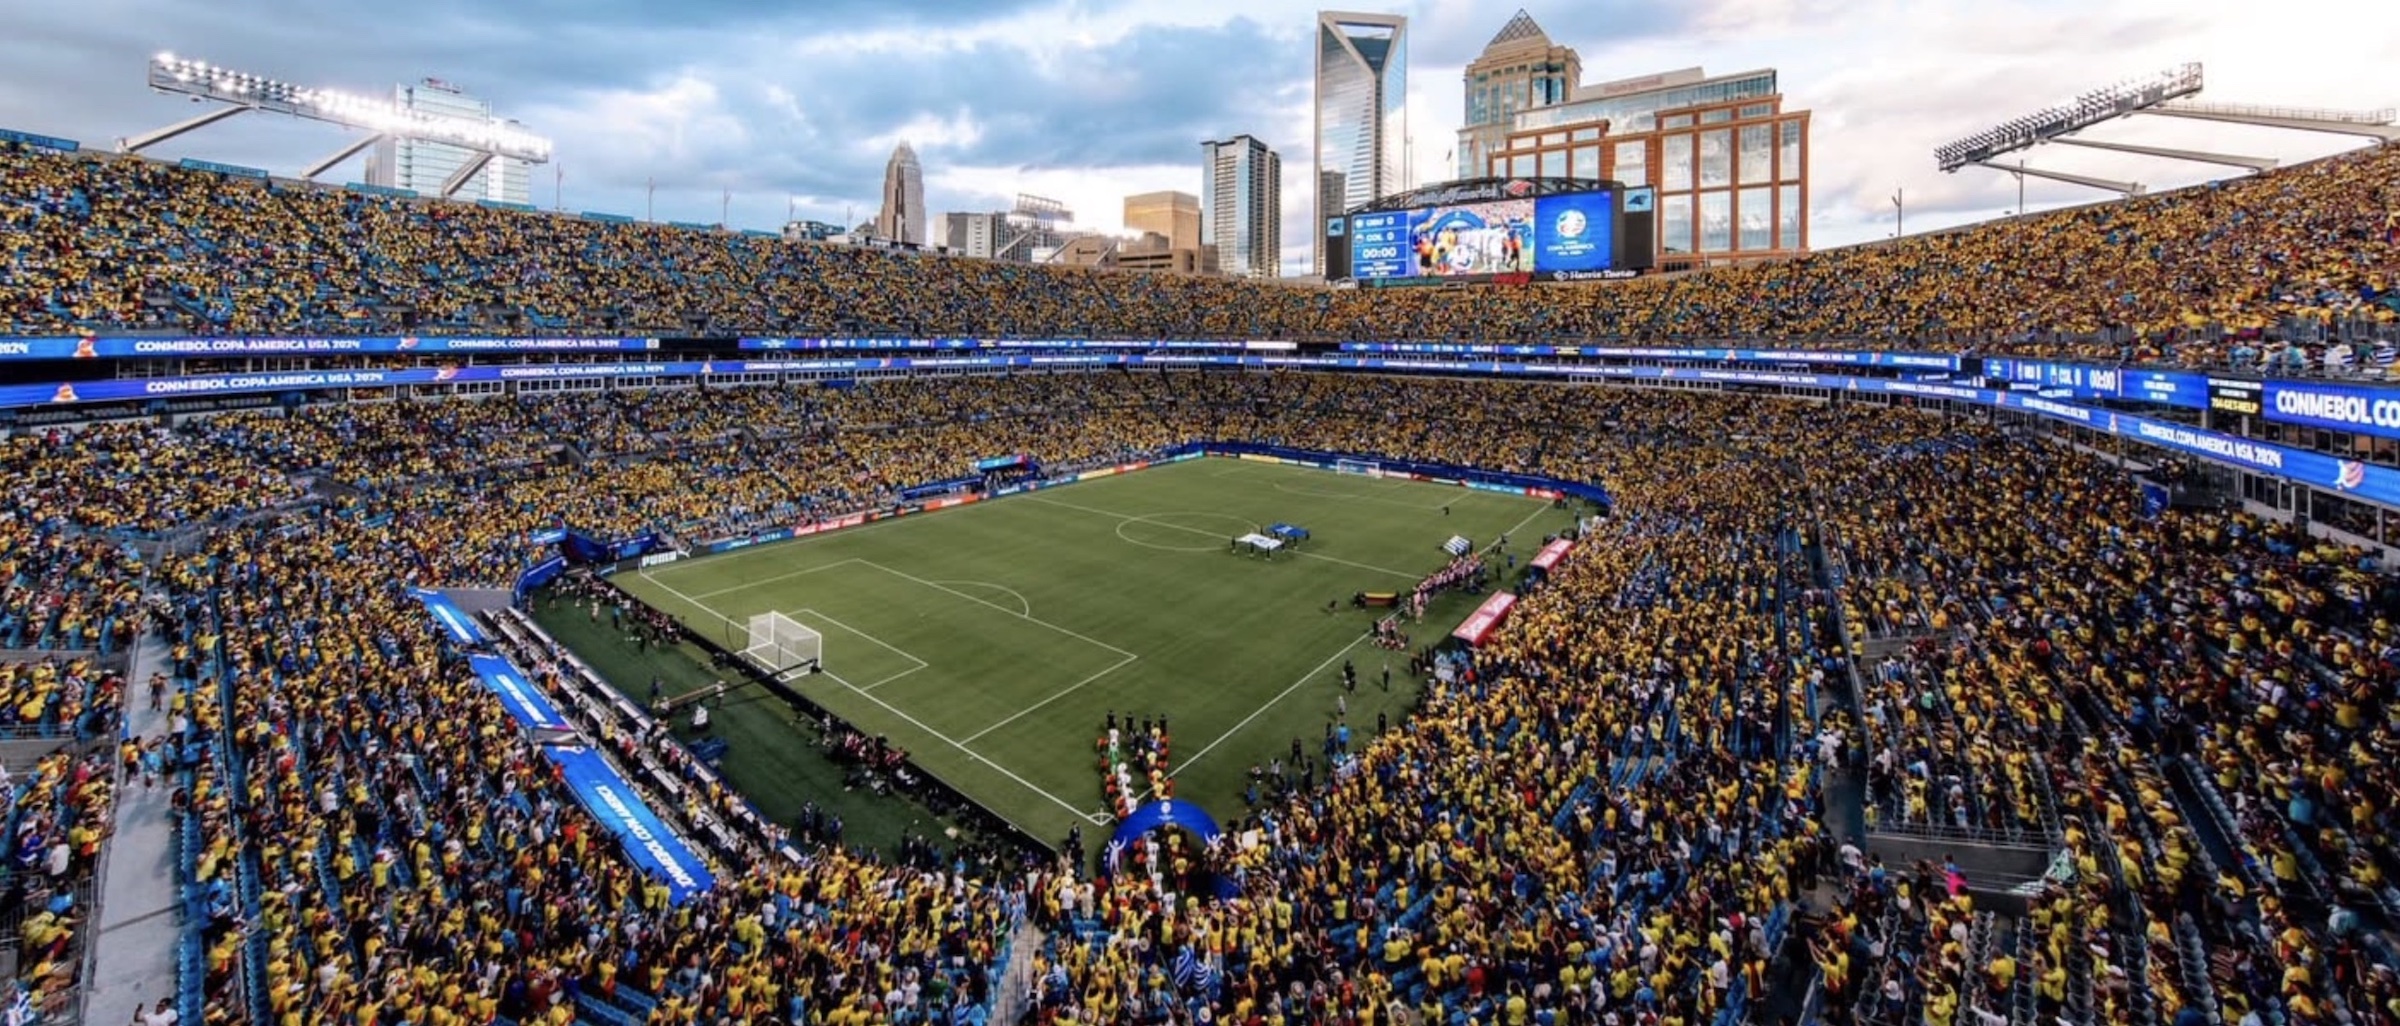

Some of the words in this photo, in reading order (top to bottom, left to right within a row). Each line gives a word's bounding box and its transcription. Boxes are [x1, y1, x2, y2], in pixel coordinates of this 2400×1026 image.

[1362, 247, 1397, 259] 00:00
[135, 341, 212, 352] CONMEBOL
[212, 340, 245, 351] COPA
[248, 340, 307, 350] AMERICA
[308, 340, 330, 349] USA
[332, 340, 361, 349] 2024
[448, 339, 507, 348] CONMEBOL
[508, 339, 536, 348] COPA
[536, 339, 578, 348] AMERICA
[501, 367, 558, 377] CONMEBOL
[559, 366, 585, 375] COPA
[585, 365, 625, 374] AMERICA
[147, 377, 229, 393] CONMEBOL
[230, 376, 267, 387] COPA
[268, 374, 325, 386] AMERICA
[328, 373, 353, 383] USA
[354, 372, 383, 382] 2024
[2275, 389, 2373, 425] CONMEBOL
[2139, 421, 2177, 443] CONMEBOL
[2176, 430, 2197, 448] COPA
[2197, 435, 2235, 458] AMERICA
[2235, 441, 2255, 464] USA
[641, 550, 677, 568] PUMA
